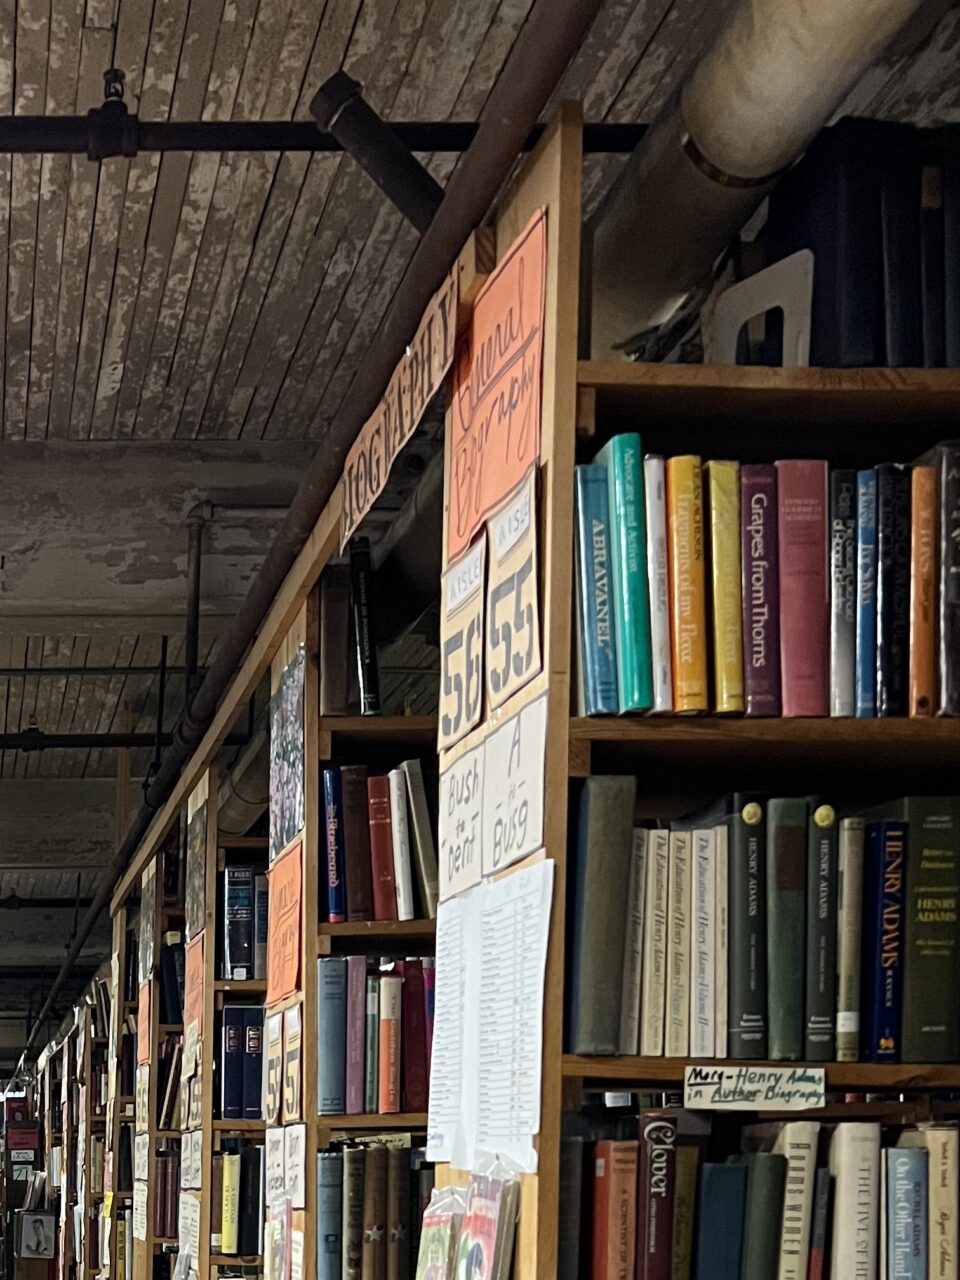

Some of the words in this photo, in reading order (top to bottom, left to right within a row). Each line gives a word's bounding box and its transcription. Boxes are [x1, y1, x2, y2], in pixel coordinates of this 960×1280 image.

[342, 280, 457, 531] IOGRAPHY
[623, 447, 639, 501] Advocate
[498, 494, 530, 547] AISLE
[626, 506, 639, 527] and
[747, 493, 769, 558] Grapes
[626, 530, 639, 573] Activist
[449, 559, 481, 602] AISLE
[592, 518, 612, 647] ABRAVANEL
[751, 560, 769, 607] from
[490, 549, 534, 693] 55
[751, 607, 769, 667] Thorns
[507, 712, 521, 778] A
[449, 758, 479, 816] Bush
[748, 837, 758, 874] HENRY
[819, 839, 829, 877] HENRY
[884, 829, 903, 895] HENRY
[748, 877, 758, 916] ADAMS
[819, 880, 829, 918] ADAMS
[917, 899, 956, 909] HENRY
[881, 899, 902, 968] ADAMS
[917, 911, 957, 922] ADAMS
[688, 1089, 703, 1101] in
[711, 1084, 761, 1102] Author
[764, 1084, 825, 1106] Biography
[736, 1067, 782, 1086] Henry
[644, 1121, 677, 1197] Clover
[787, 1142, 812, 1194] ADAMS
[895, 1158, 912, 1177] On
[856, 1165, 871, 1198] THE
[895, 1179, 912, 1201] the
[913, 1181, 921, 1220] RACHEL
[619, 1199, 628, 1246] SCIENTIST
[782, 1203, 804, 1255] WOMEN
[856, 1202, 870, 1236] FIVE
[895, 1202, 912, 1239] Other
[619, 1251, 628, 1264] OF
[855, 1239, 870, 1258] OF
[894, 1240, 911, 1277] Hand
[913, 1223, 921, 1258] ADAMS
